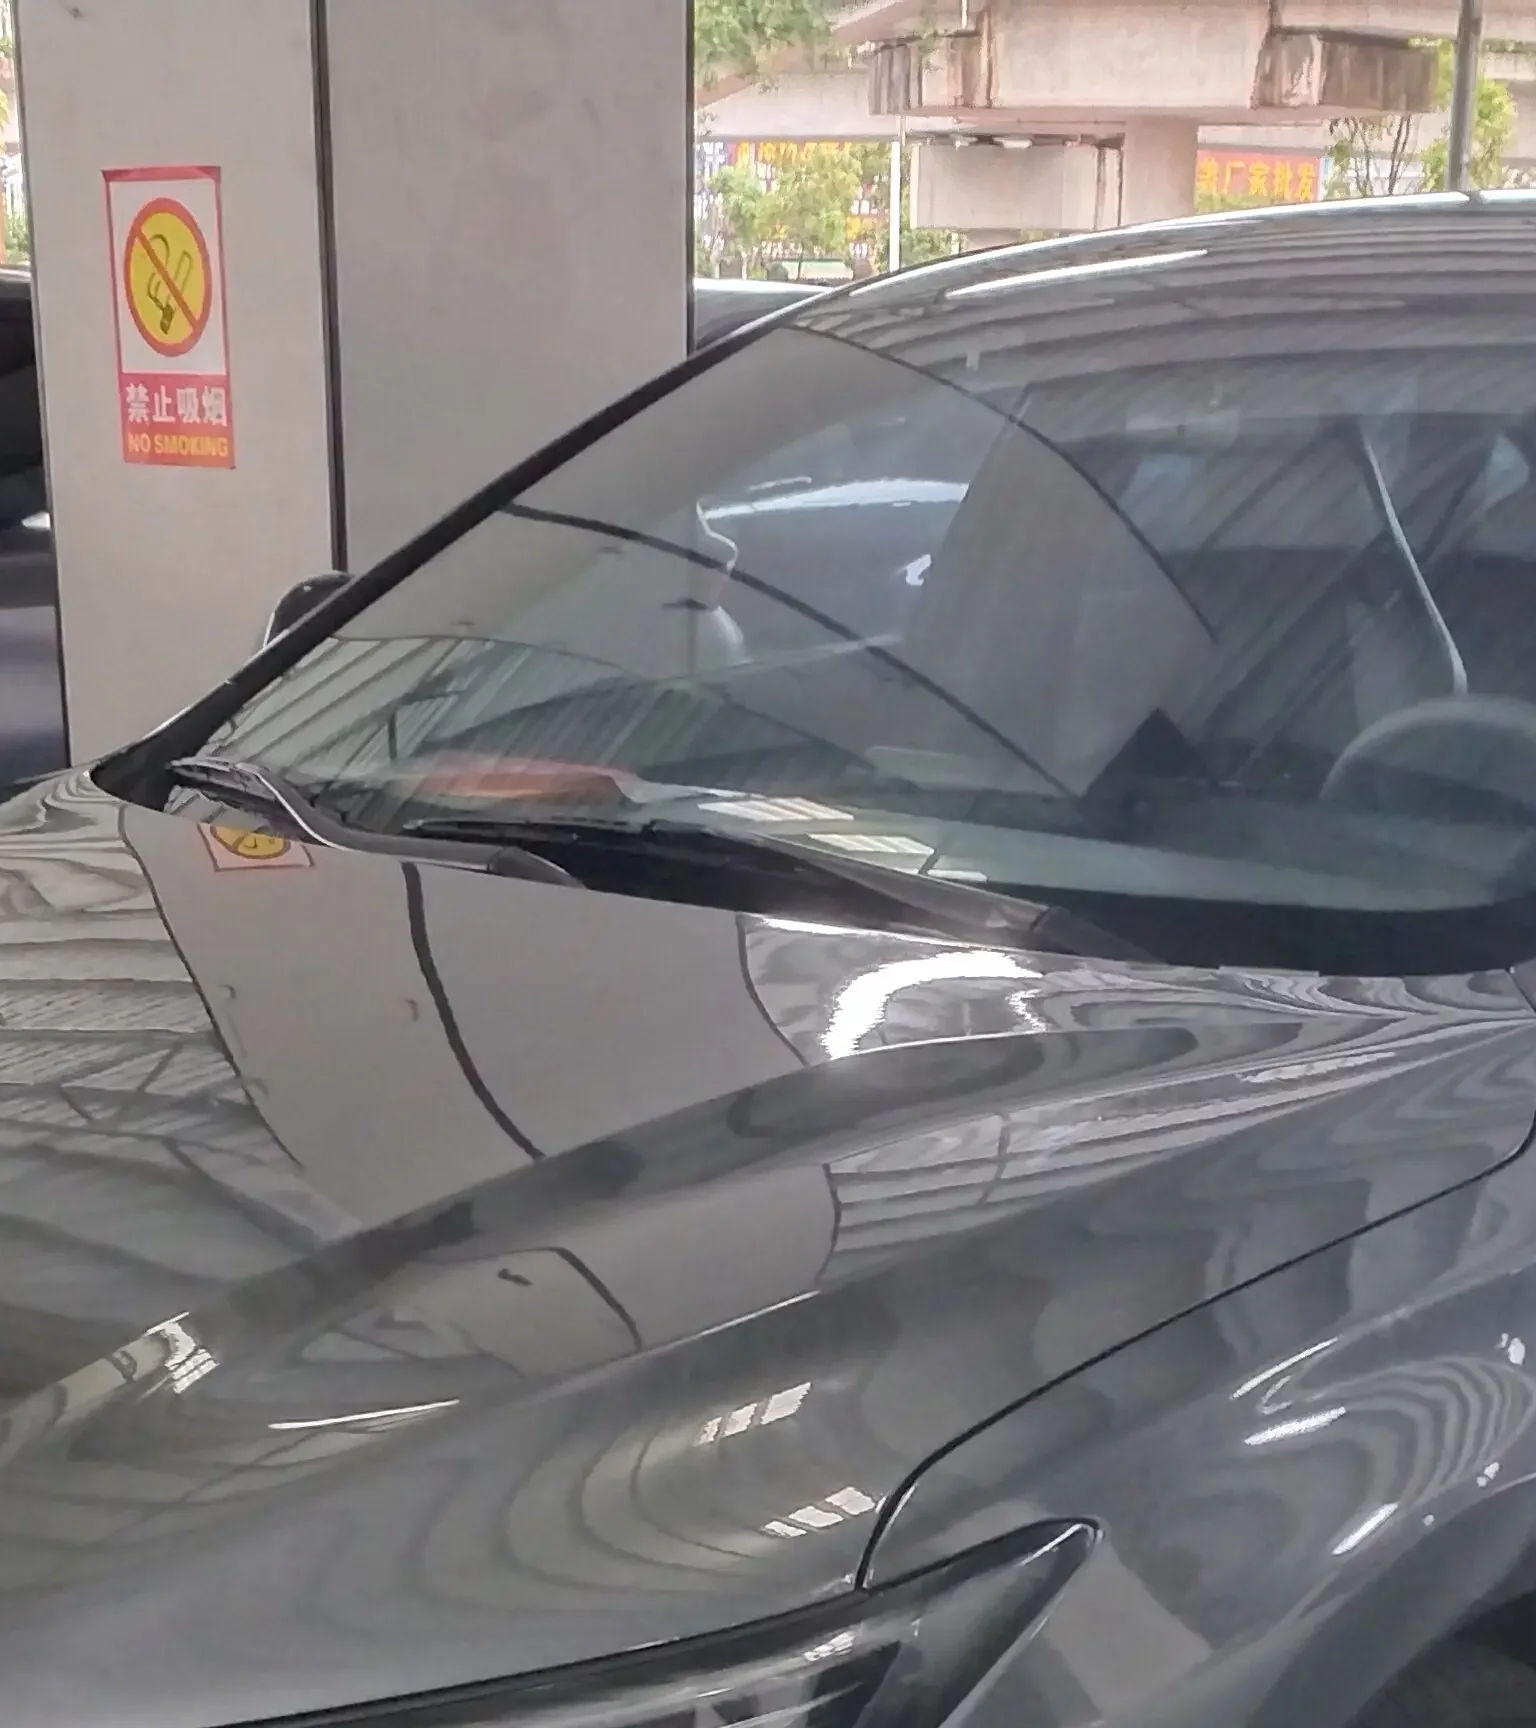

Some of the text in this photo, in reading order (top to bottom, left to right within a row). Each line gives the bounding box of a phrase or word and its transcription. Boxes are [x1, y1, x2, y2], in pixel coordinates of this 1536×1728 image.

[126, 383, 227, 427] 禁止吸烟
[128, 432, 228, 457] NO SMOKING
